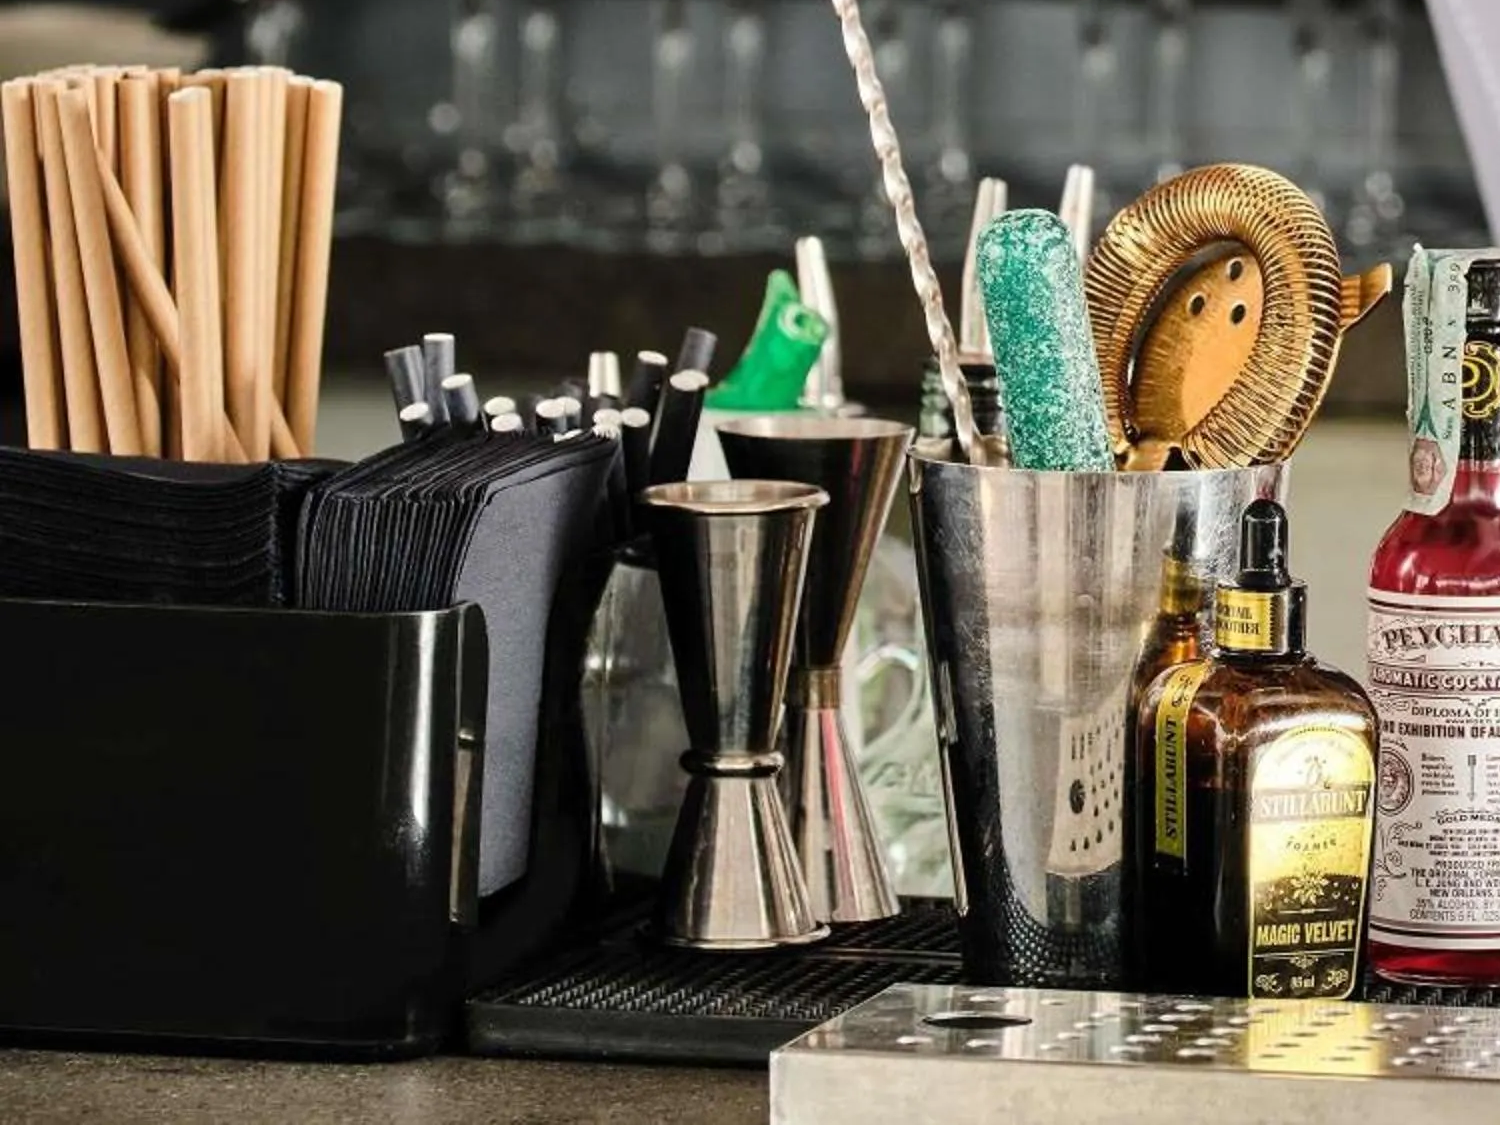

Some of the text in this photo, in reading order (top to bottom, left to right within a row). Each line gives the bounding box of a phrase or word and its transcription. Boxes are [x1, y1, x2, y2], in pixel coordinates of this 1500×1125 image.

[1399, 722, 1465, 738] EXHIBITION
[1256, 918, 1356, 948] MAGIC VELVET
